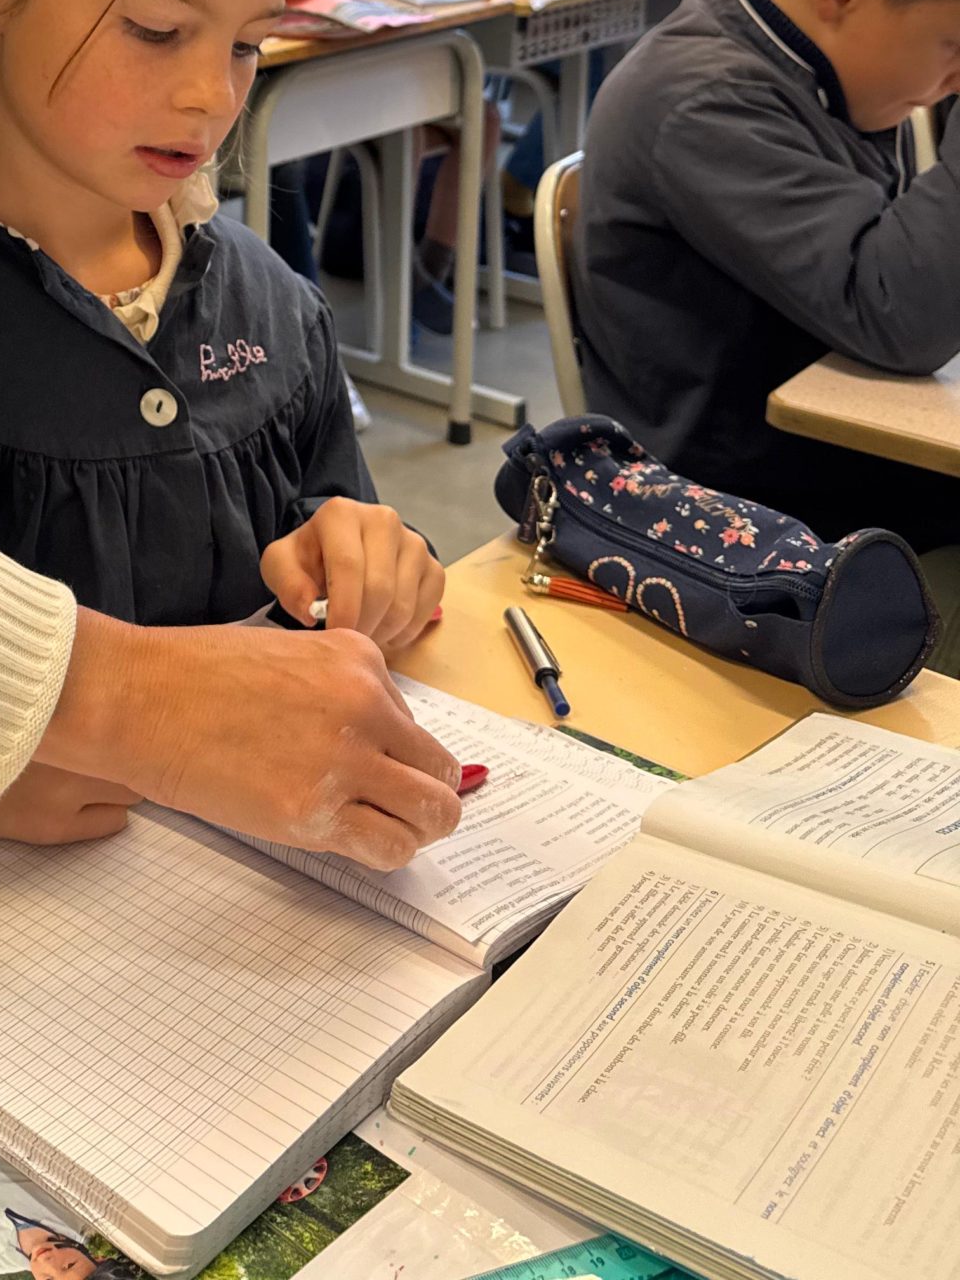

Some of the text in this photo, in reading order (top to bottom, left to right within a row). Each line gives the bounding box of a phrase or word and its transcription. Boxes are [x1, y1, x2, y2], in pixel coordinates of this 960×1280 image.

[689, 897, 712, 918] Ajoutez
[671, 925, 686, 939] nom
[641, 938, 674, 976] complément
[623, 975, 646, 997] d'objet
[880, 962, 909, 999] complément
[904, 968, 930, 995] Encadrez
[605, 996, 627, 1021] second
[866, 998, 888, 1021] d'objet
[595, 1019, 609, 1032] aux
[876, 1024, 891, 1041] nom
[561, 1030, 599, 1071] propositions
[847, 1044, 879, 1087] complément
[534, 1070, 565, 1101] suivantes
[830, 1089, 853, 1114] d'objet
[815, 1116, 836, 1138] direct
[782, 1151, 811, 1187] soulignez
[760, 1200, 778, 1219] nom
[561, 1266, 577, 1277] 18
[590, 1257, 605, 1268] 19
